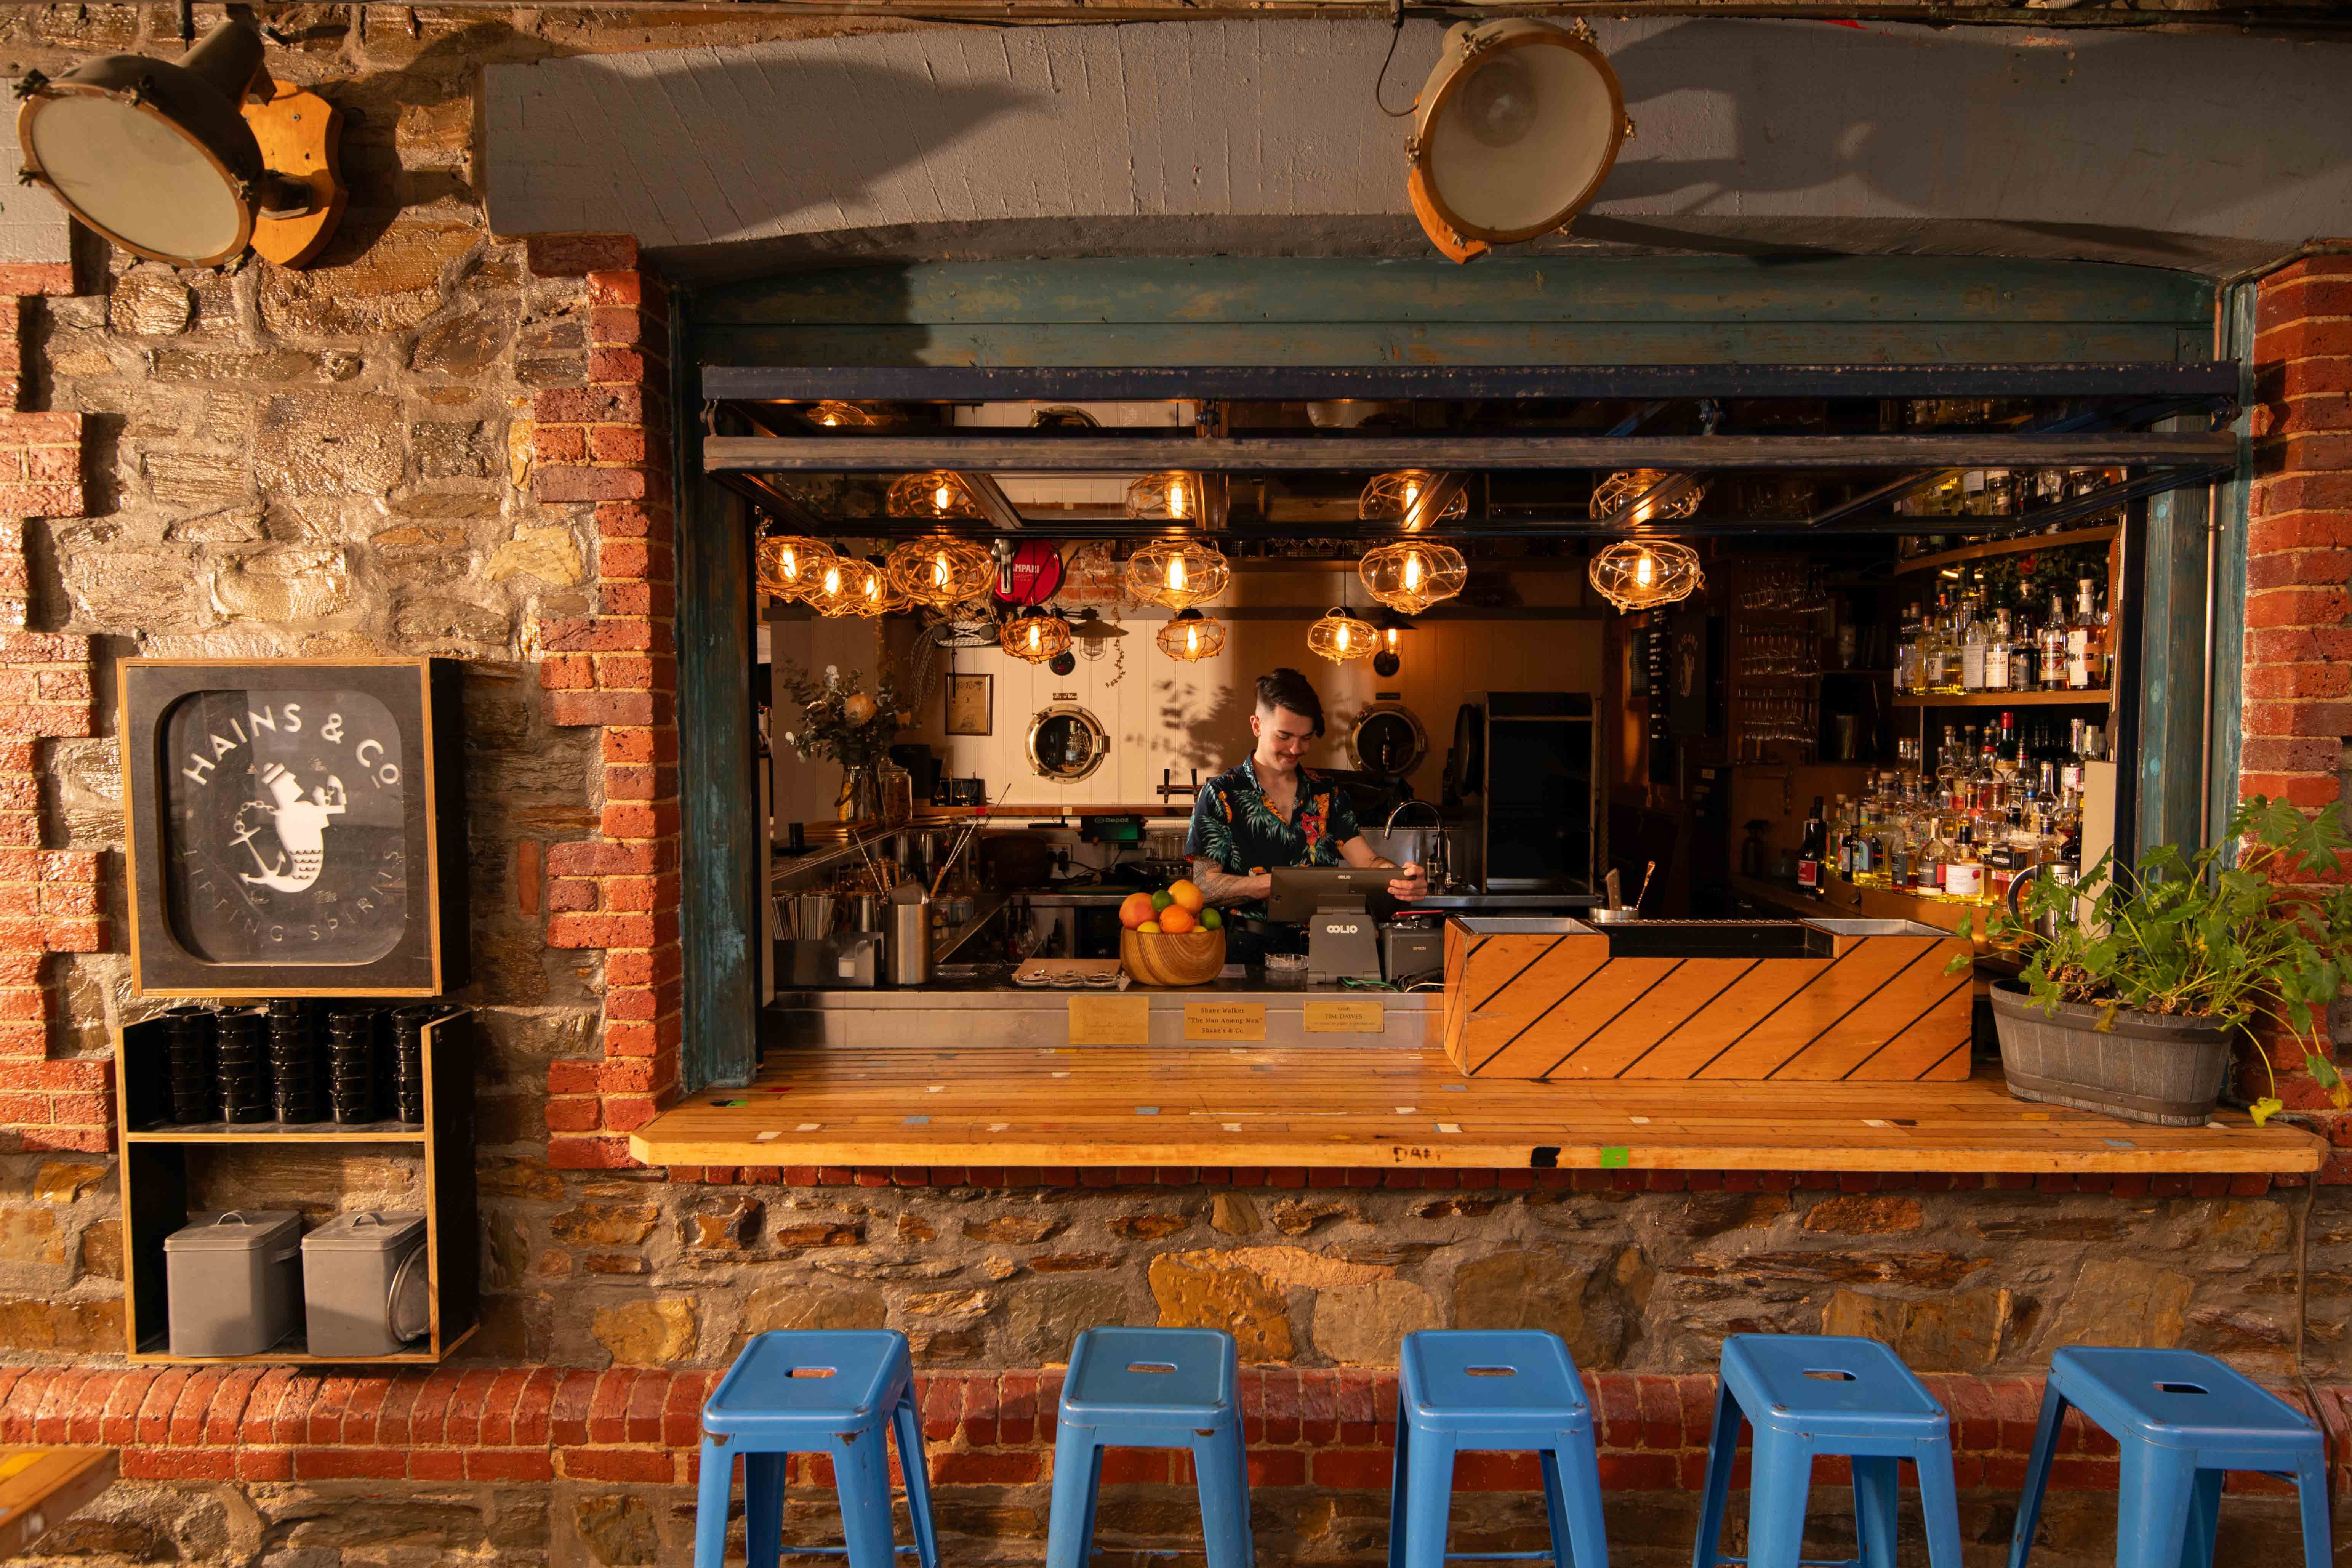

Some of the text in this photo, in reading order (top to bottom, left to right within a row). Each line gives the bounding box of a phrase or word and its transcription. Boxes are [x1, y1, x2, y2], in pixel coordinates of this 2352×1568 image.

[1013, 564, 1040, 573] MPARI
[182, 703, 301, 786] HAINS
[320, 713, 344, 744] &
[1327, 925, 1358, 934] OOLIO
